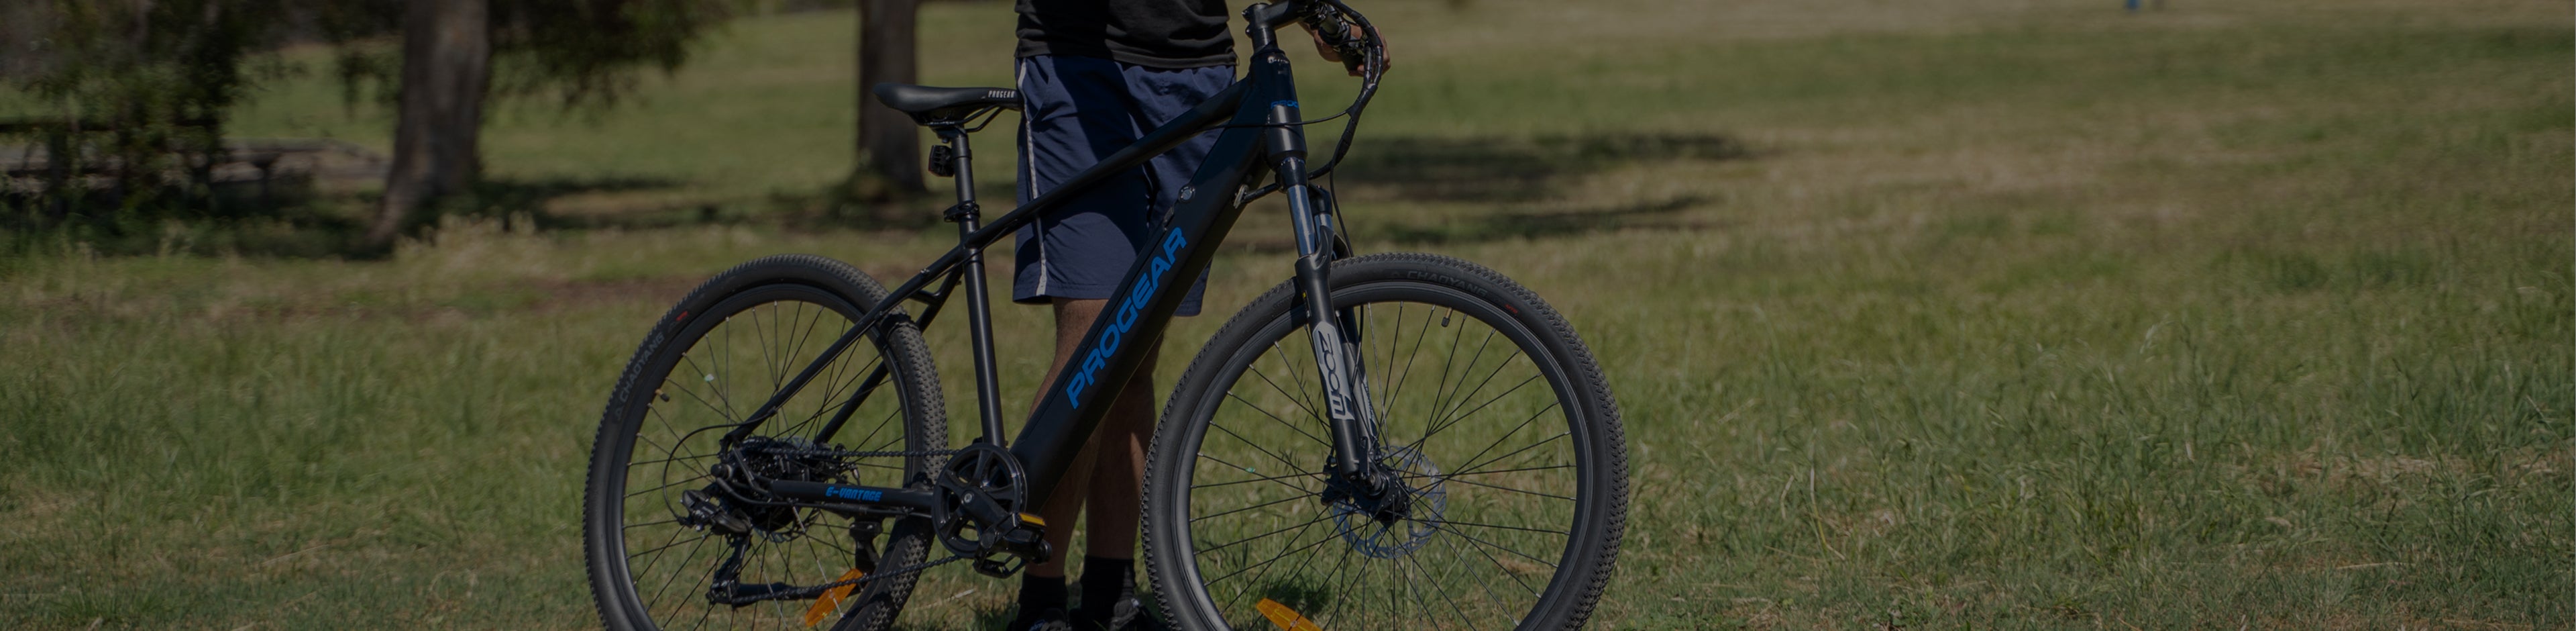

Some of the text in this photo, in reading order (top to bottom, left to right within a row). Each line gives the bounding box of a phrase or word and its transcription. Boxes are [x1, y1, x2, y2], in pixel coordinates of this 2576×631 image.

[1406, 270, 1488, 297] CHAOYANG
[1065, 226, 1187, 409] PROGEAR
[619, 332, 665, 403] CHAOYANG
[825, 485, 883, 503] E-VANTAGE
